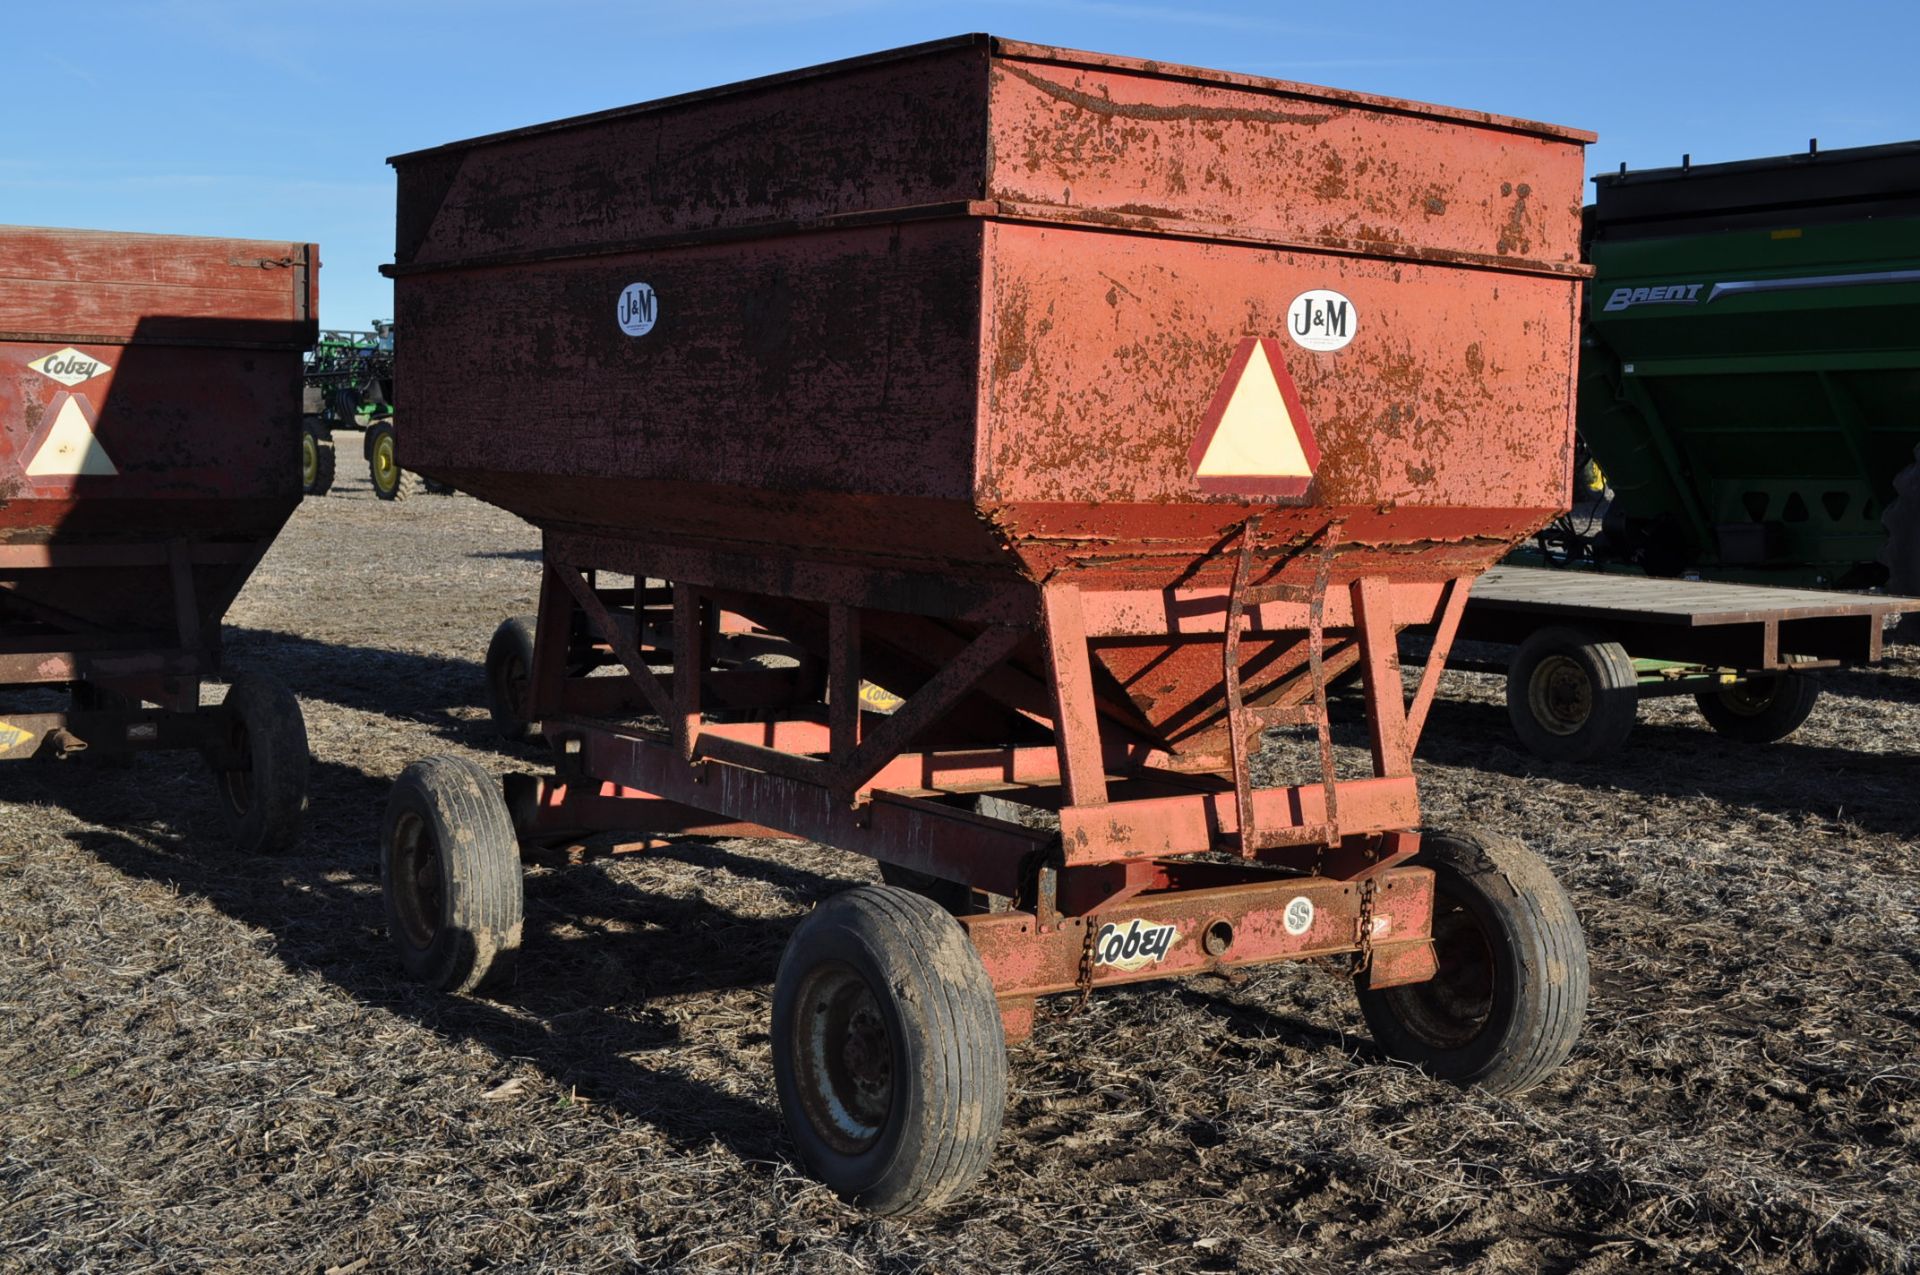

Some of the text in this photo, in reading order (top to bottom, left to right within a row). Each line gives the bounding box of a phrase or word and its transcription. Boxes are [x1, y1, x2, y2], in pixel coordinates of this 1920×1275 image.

[620, 289, 652, 325] J&M
[1603, 284, 1704, 311] BRENT
[1294, 298, 1348, 337] J&M
[43, 355, 98, 380] Cobey
[1095, 920, 1175, 963] Cobey
